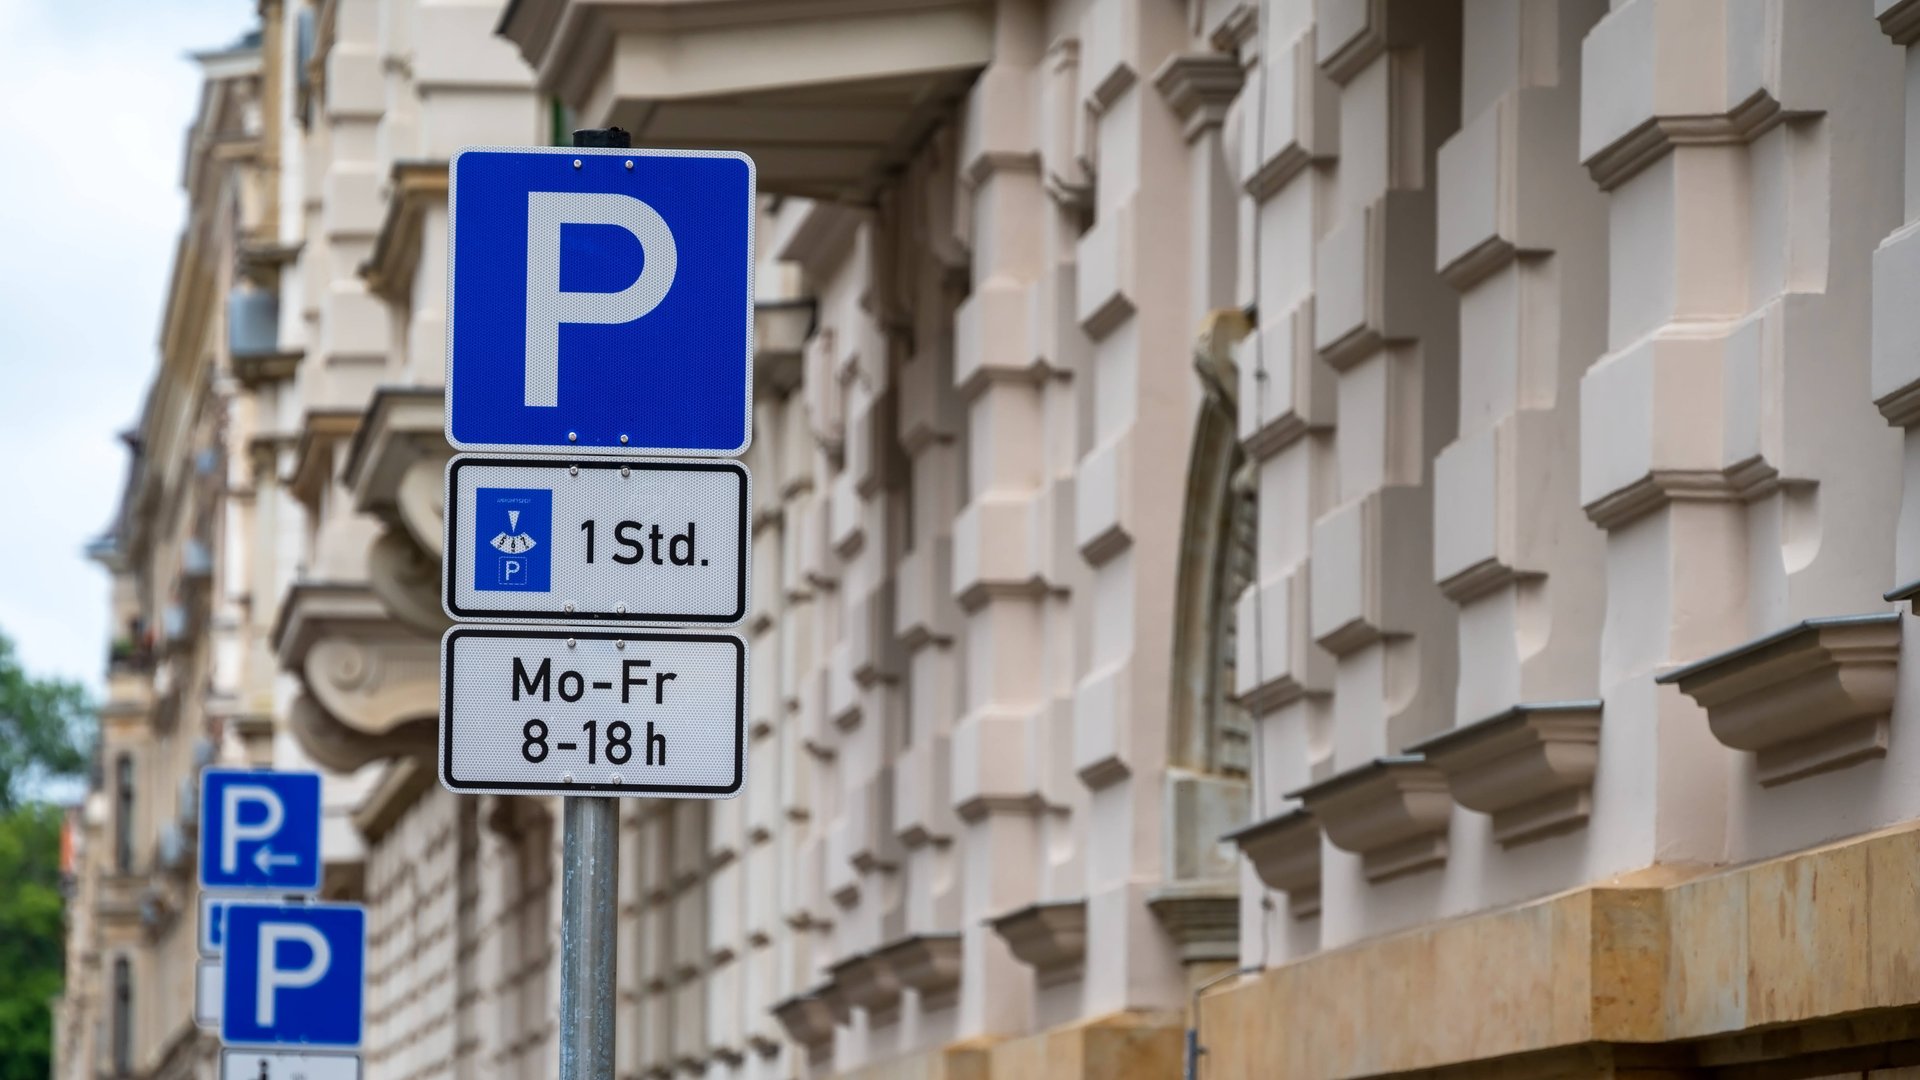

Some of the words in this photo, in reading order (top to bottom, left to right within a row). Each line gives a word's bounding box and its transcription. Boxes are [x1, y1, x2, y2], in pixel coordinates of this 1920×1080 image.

[524, 191, 678, 408] P
[581, 520, 594, 564] 1
[612, 521, 709, 566] Std.
[505, 560, 520, 581] P
[512, 657, 677, 704] Mo-Fr
[522, 719, 632, 765] 8-18
[646, 721, 666, 766] h
[220, 784, 286, 875] P
[255, 922, 332, 1028] P
